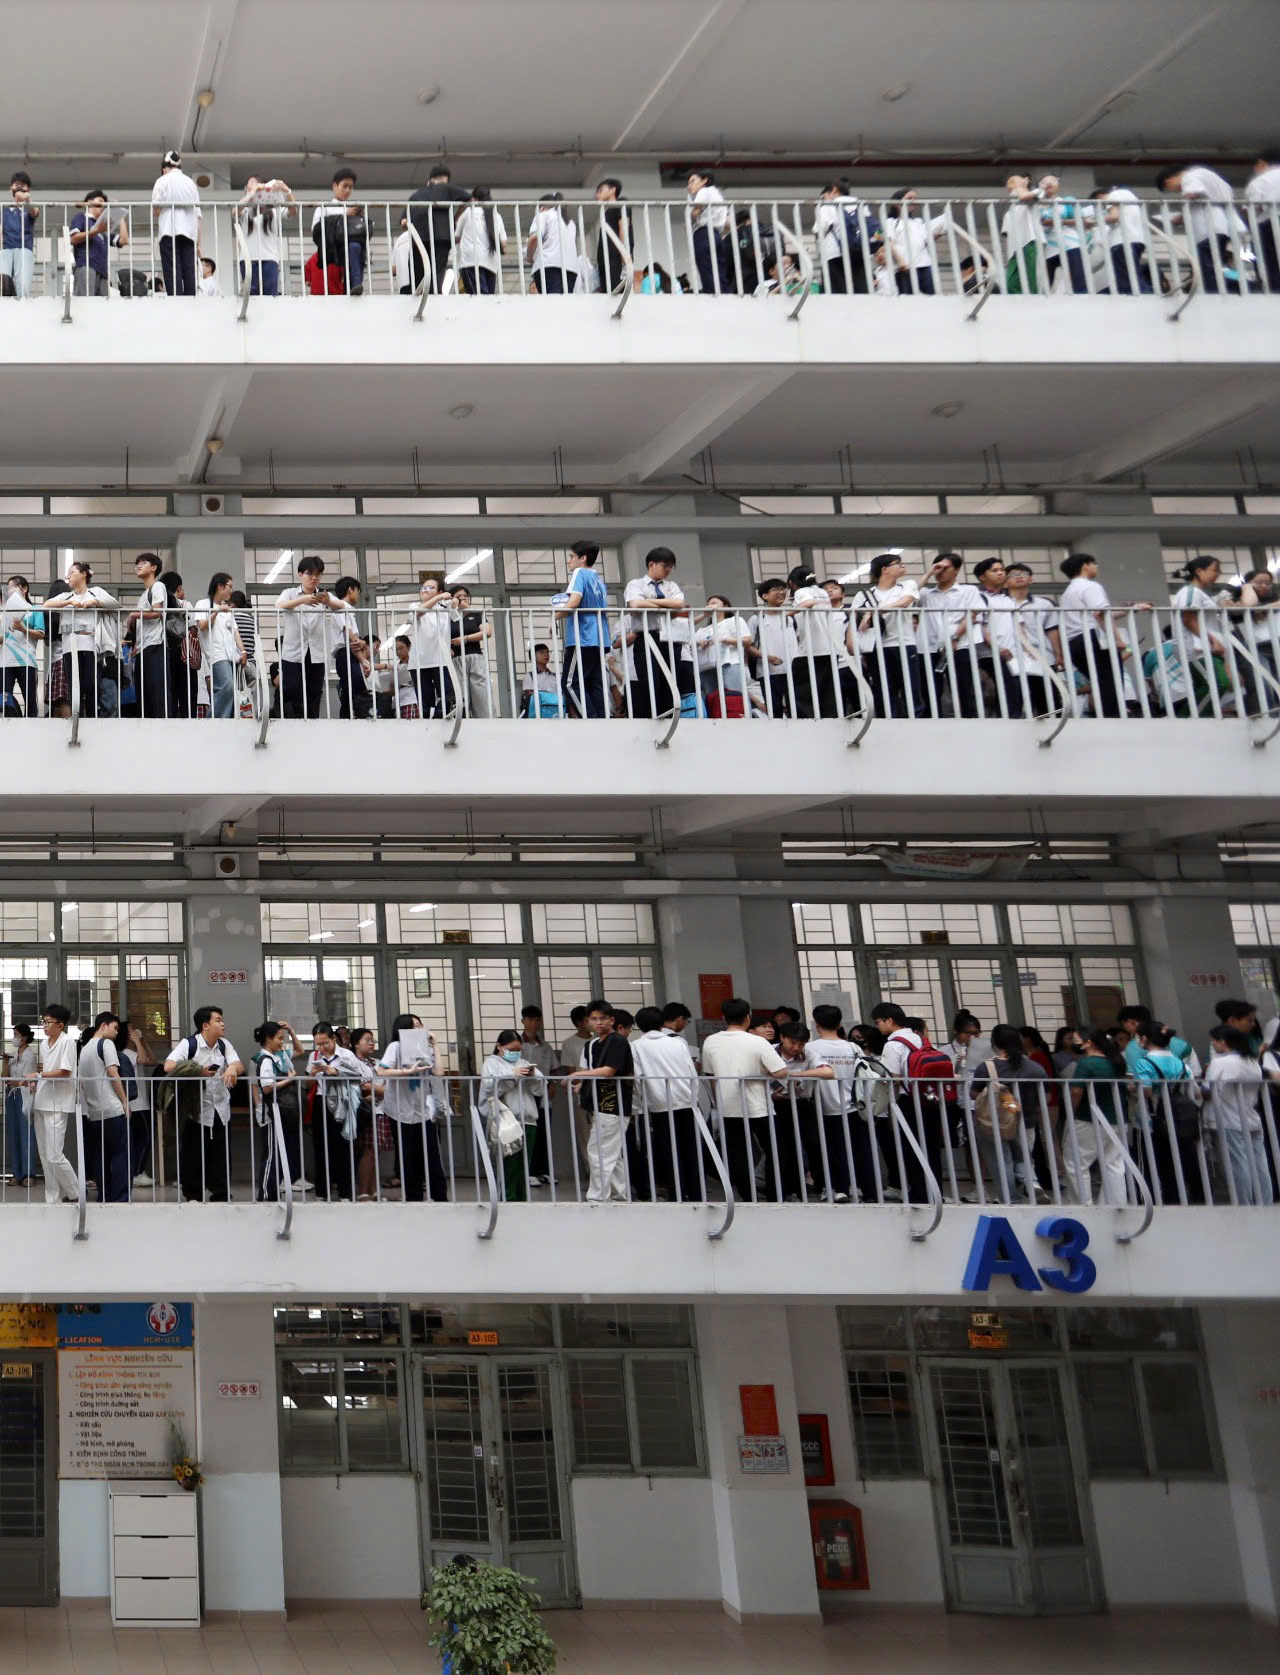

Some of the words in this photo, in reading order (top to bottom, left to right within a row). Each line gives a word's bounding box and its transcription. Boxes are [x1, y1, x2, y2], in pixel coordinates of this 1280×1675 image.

[961, 1215, 1096, 1293] A3
[472, 1334, 496, 1342] A3-105
[6, 1366, 30, 1375] A3-106
[826, 1544, 849, 1553] PCCC
